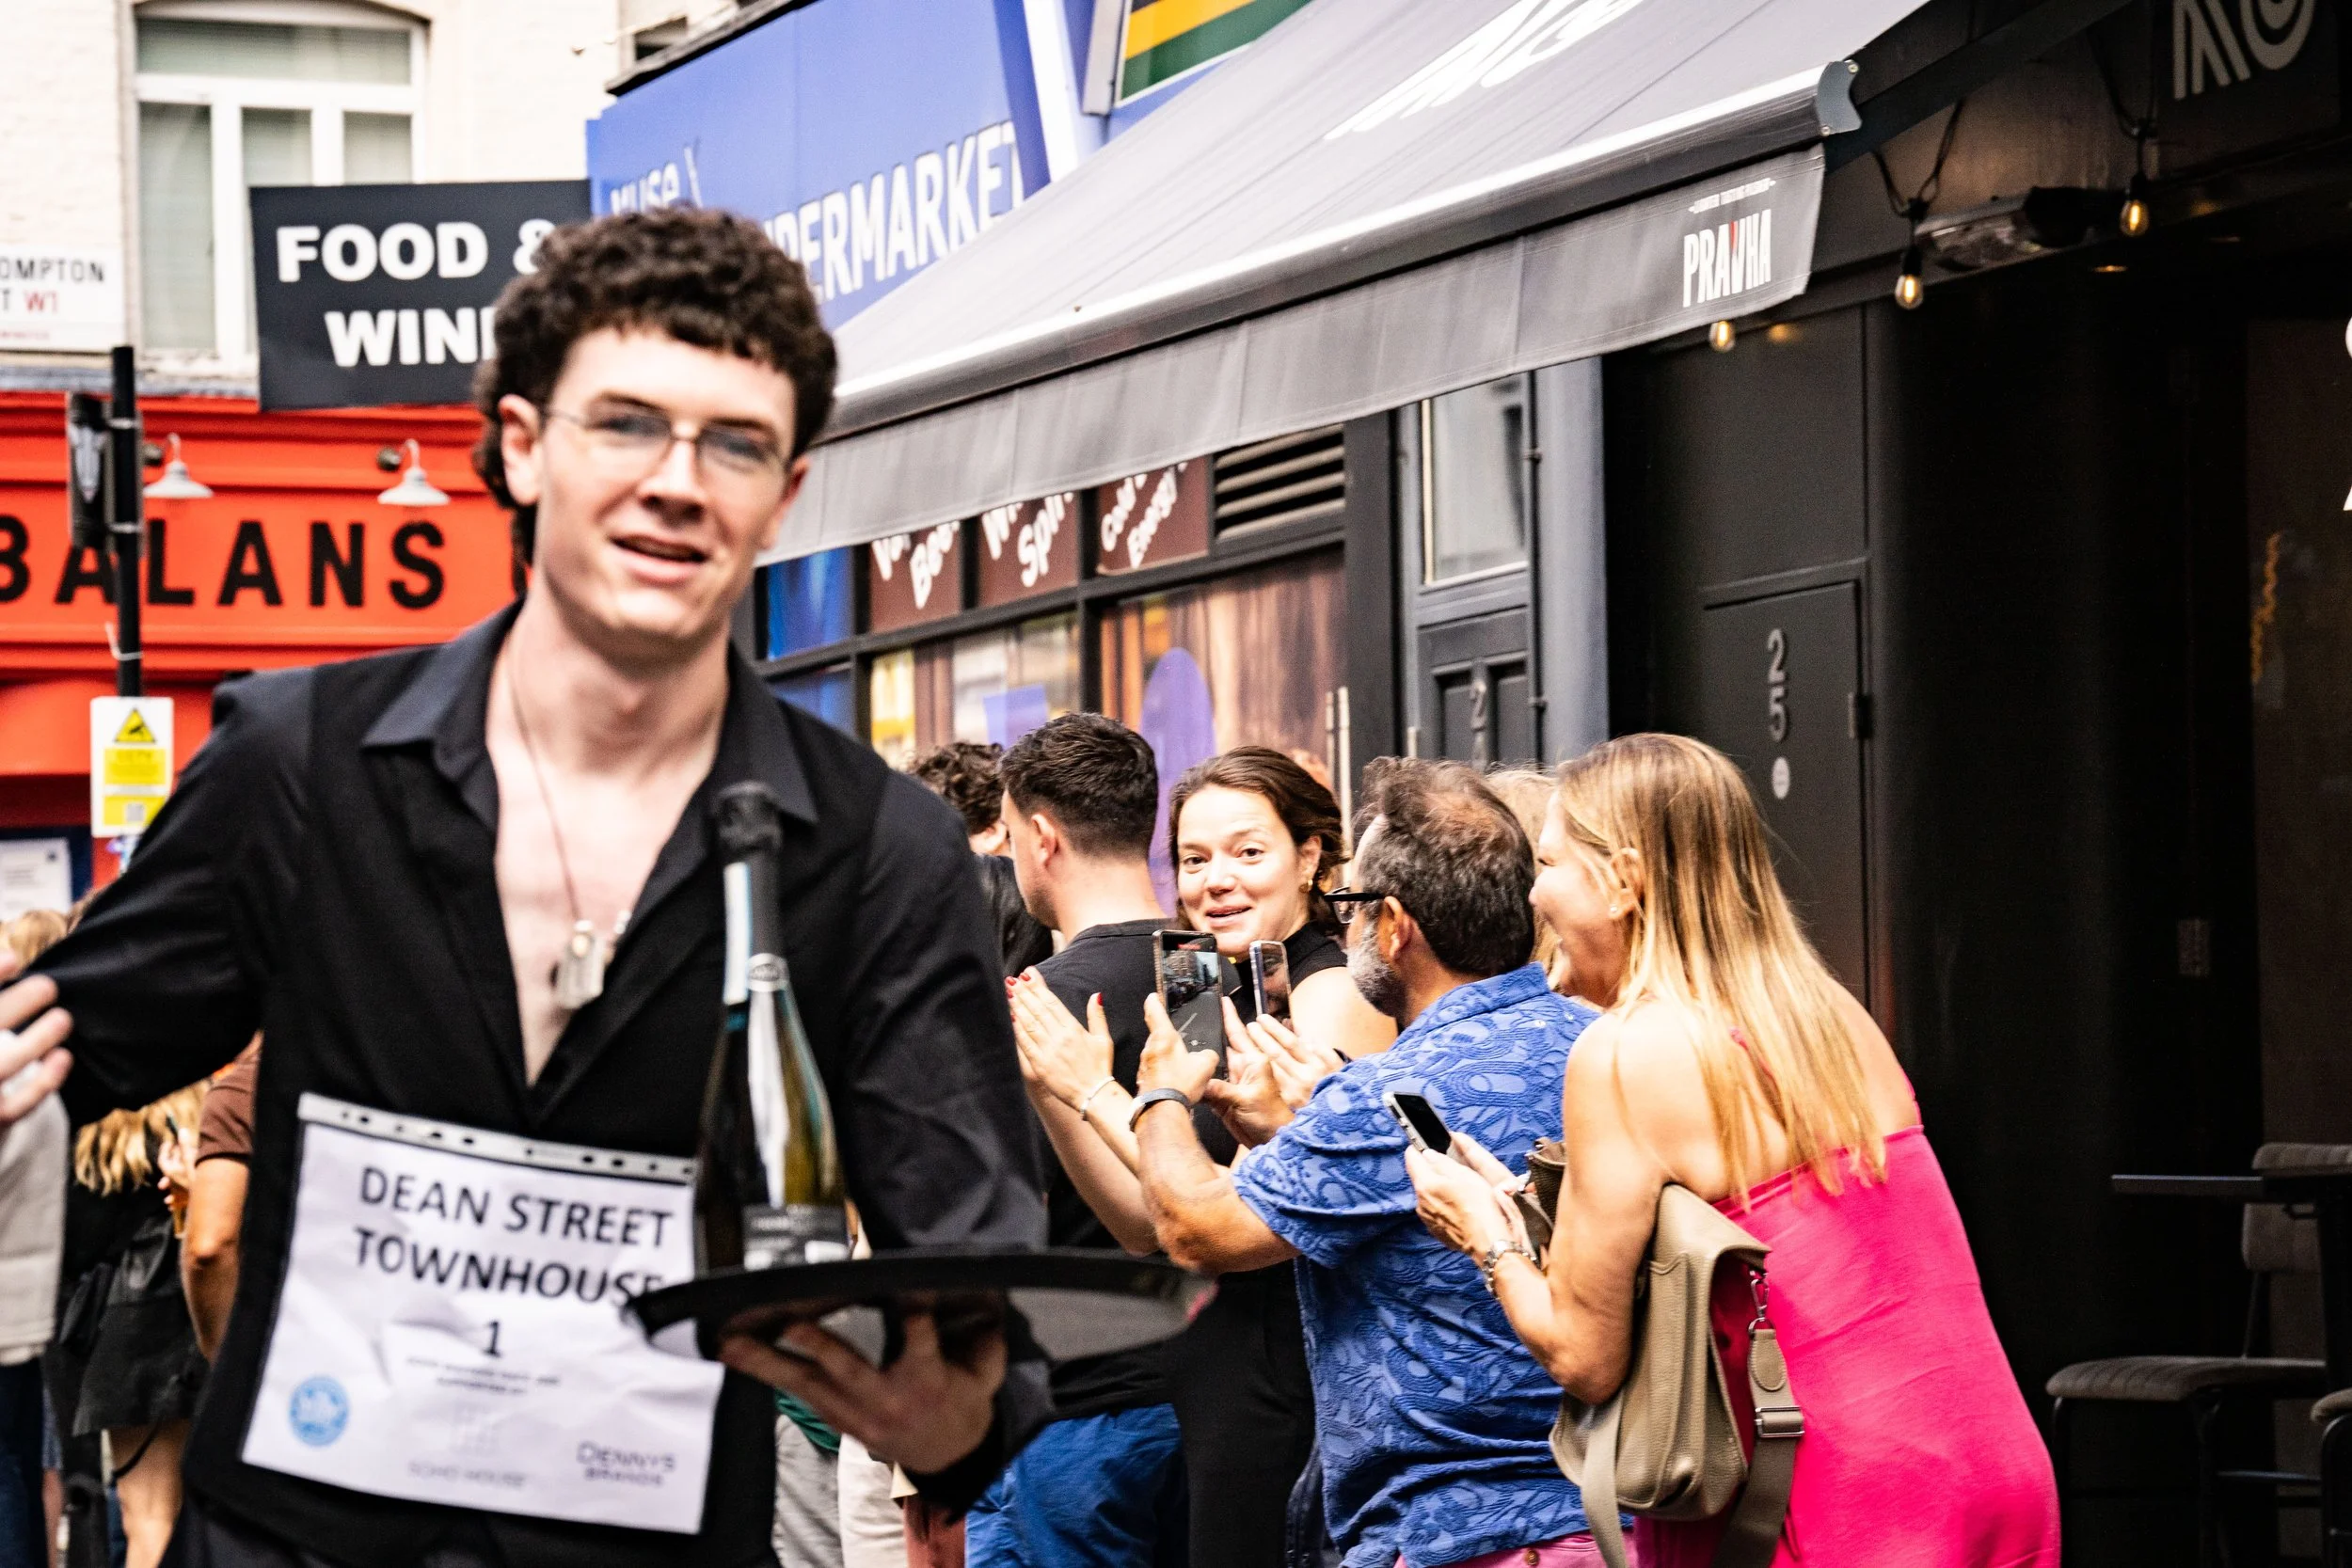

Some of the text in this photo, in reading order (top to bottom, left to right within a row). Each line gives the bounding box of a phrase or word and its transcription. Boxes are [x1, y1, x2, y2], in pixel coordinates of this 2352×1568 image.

[277, 221, 488, 282] FOOD
[762, 119, 1025, 305] PERMARKET
[1682, 208, 1772, 309] PRAVHA
[0, 514, 445, 610] BALANS
[359, 1164, 675, 1249] DEAN STREET
[483, 1319, 503, 1358] 1
